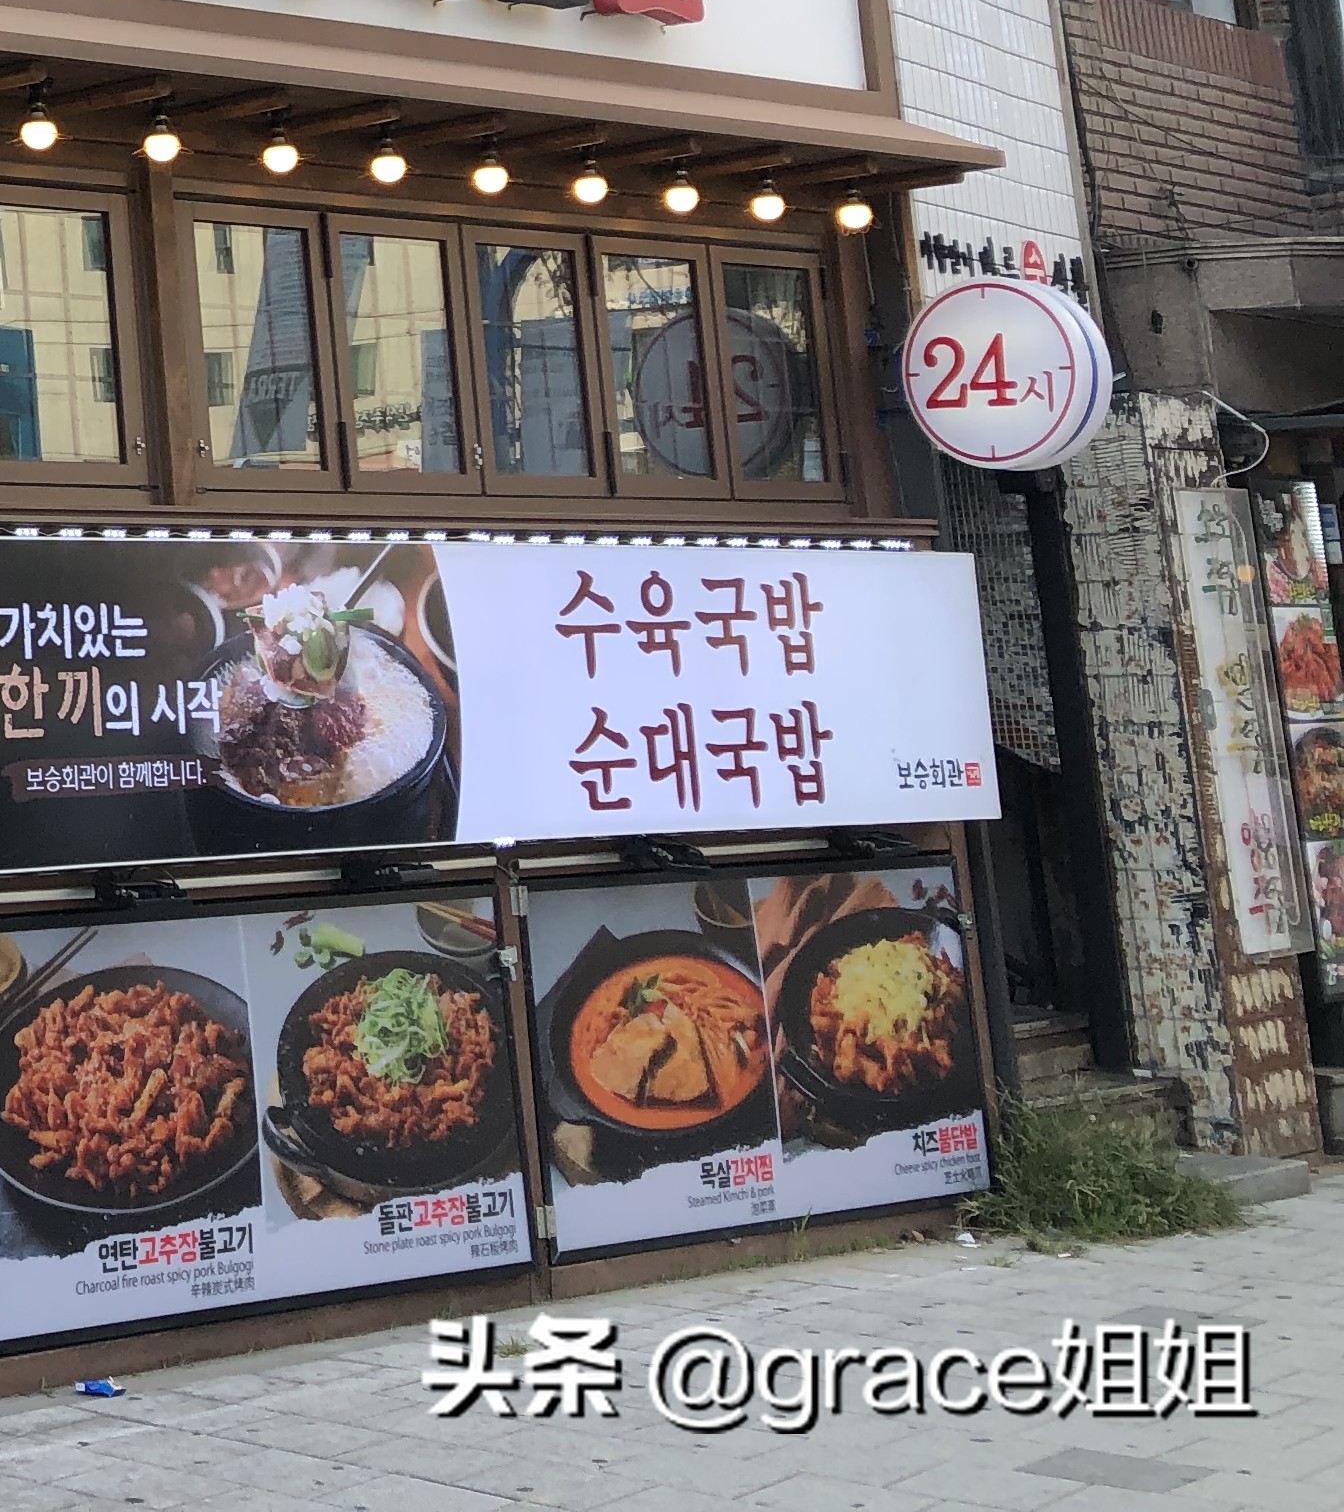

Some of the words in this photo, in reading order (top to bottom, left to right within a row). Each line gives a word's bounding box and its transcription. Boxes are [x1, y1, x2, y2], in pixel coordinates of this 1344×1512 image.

[922, 332, 1056, 413] 24시
[555, 569, 824, 679] 수육국밥
[0, 665, 46, 740] 한
[151, 678, 222, 736] 시작
[568, 700, 833, 813] 순대국밥
[897, 758, 965, 791] 보승회관
[26, 763, 115, 793] 보승회관이
[118, 760, 208, 789] 함께합니다.
[912, 1121, 979, 1158] 치즈불닭발
[700, 1153, 774, 1190] 목살김치찜
[378, 1188, 515, 1236] 돌판고추장불고기
[687, 1193, 722, 1209] Steamed
[723, 1189, 749, 1203] Kimchi
[758, 1184, 775, 1200] pork
[98, 1222, 254, 1274] 연탄고추장불고기
[363, 1240, 390, 1255] Stone
[392, 1237, 414, 1253] plate
[416, 1235, 438, 1248] roast
[439, 1231, 461, 1246] spicy
[462, 1228, 482, 1243] pork
[484, 1223, 517, 1238] Bulgogi
[75, 1275, 120, 1296] Charcoal
[121, 1275, 139, 1288] fire
[141, 1273, 164, 1286] roast
[166, 1269, 191, 1284] spicy
[193, 1267, 215, 1281] pork
[217, 1259, 254, 1276] Bulgogi
